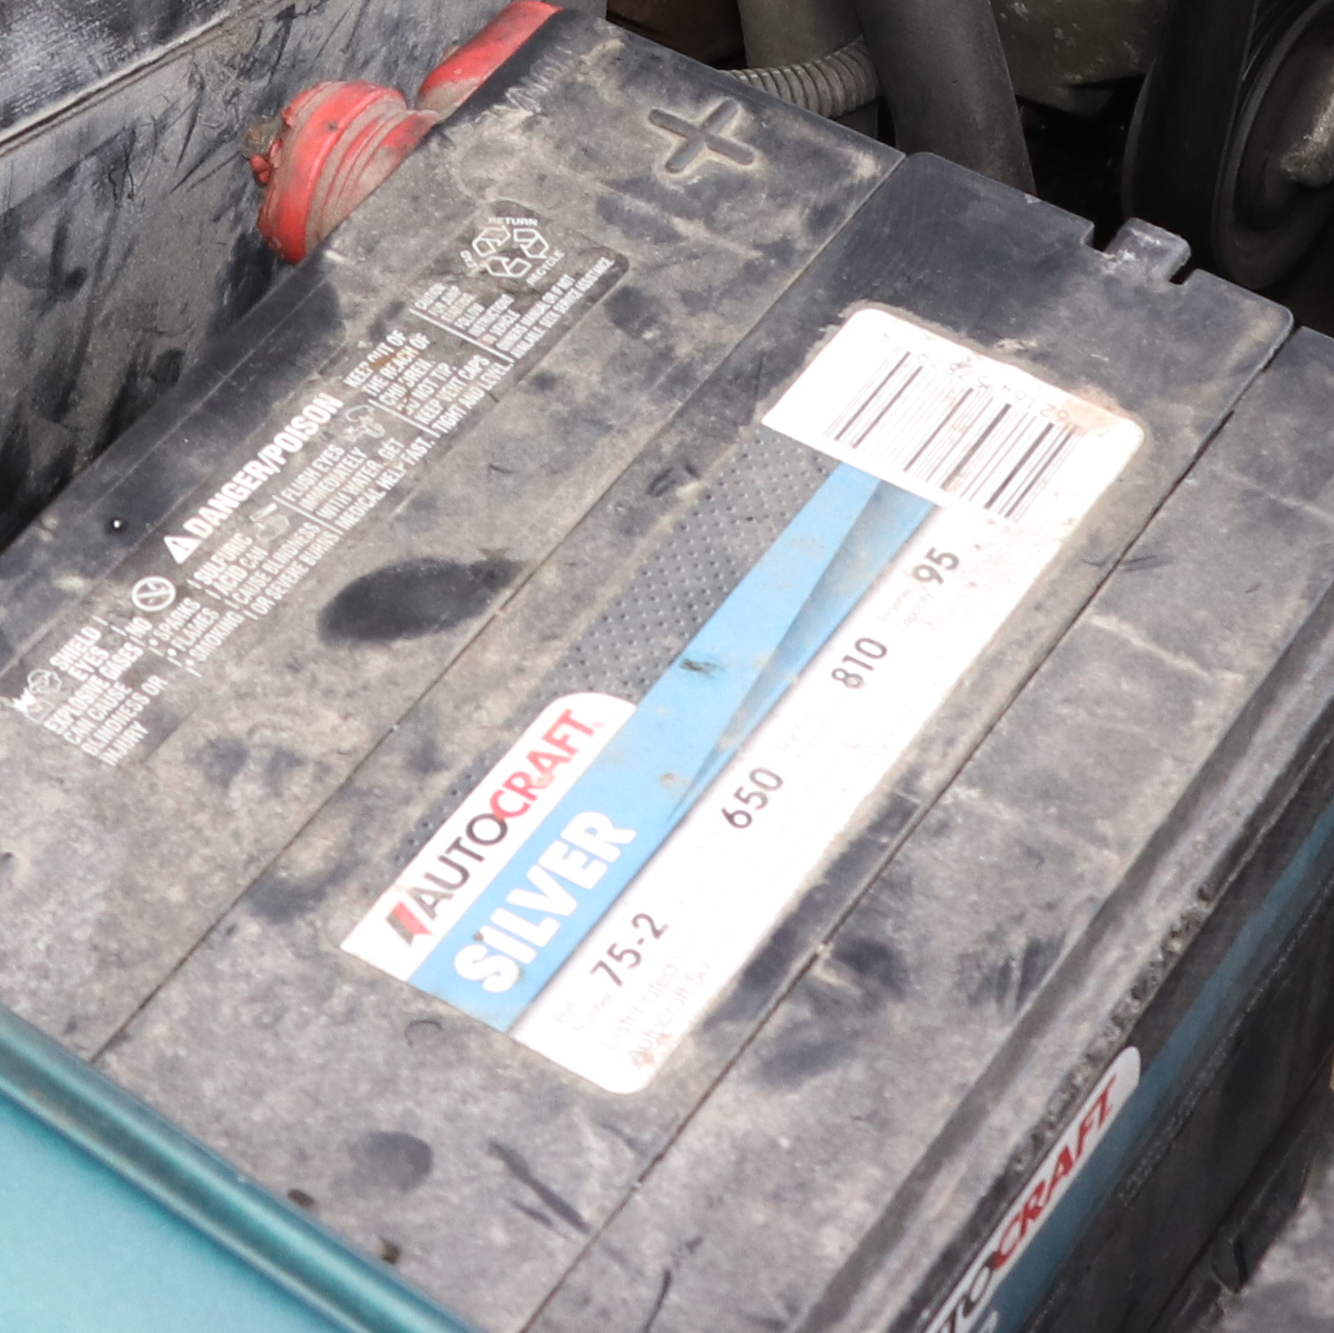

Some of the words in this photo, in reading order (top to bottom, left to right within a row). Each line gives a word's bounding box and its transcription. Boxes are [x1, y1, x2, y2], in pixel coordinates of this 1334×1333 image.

[525, 250, 566, 287] RECYCLE
[360, 372, 390, 398] THE
[407, 330, 432, 351] OF
[384, 327, 408, 348] OF
[410, 375, 439, 402] NOT
[428, 359, 458, 383] TIP.
[413, 397, 445, 425] KEEP
[434, 374, 468, 404] VENT
[456, 352, 491, 382] CAPS
[430, 402, 468, 435] TIGHT
[457, 384, 486, 410] AND
[182, 389, 344, 540] DANGER/POISON
[279, 465, 322, 504] FLUSH
[310, 441, 345, 473] EYES
[297, 446, 368, 513] IMMEDIATELY
[315, 489, 352, 521] WITH
[376, 435, 405, 462] GET
[333, 484, 387, 532] MEDICAL
[191, 530, 254, 586] SULFURIC
[211, 562, 248, 596] ACID
[237, 543, 269, 571] CAN
[230, 568, 272, 606] CAUSE
[260, 519, 321, 576] BLINDNESS
[248, 592, 276, 617] OR
[263, 559, 310, 601] SEVERE
[297, 528, 341, 568] BURNS
[911, 547, 959, 584] 95
[123, 614, 154, 640] NO
[151, 595, 202, 641] SPARKS
[169, 605, 220, 652] FLAMES
[187, 608, 245, 663] SMOKING
[47, 623, 103, 672] SHIELD
[66, 643, 111, 682] EYES
[830, 637, 887, 689] 810
[41, 673, 111, 735] EXPLOSIVE
[97, 640, 145, 681] GASES
[60, 716, 97, 745] CAN
[85, 679, 133, 722] CAUSE
[79, 691, 151, 756] BLINDNESS
[139, 672, 169, 697] OR
[98, 719, 150, 767] INJURY
[413, 711, 591, 916] AUTOCRAFT
[721, 768, 783, 829] 650
[455, 811, 633, 991] SILVER
[591, 912, 666, 986] 75-2
[935, 1075, 1117, 1333] TOCRAFT
